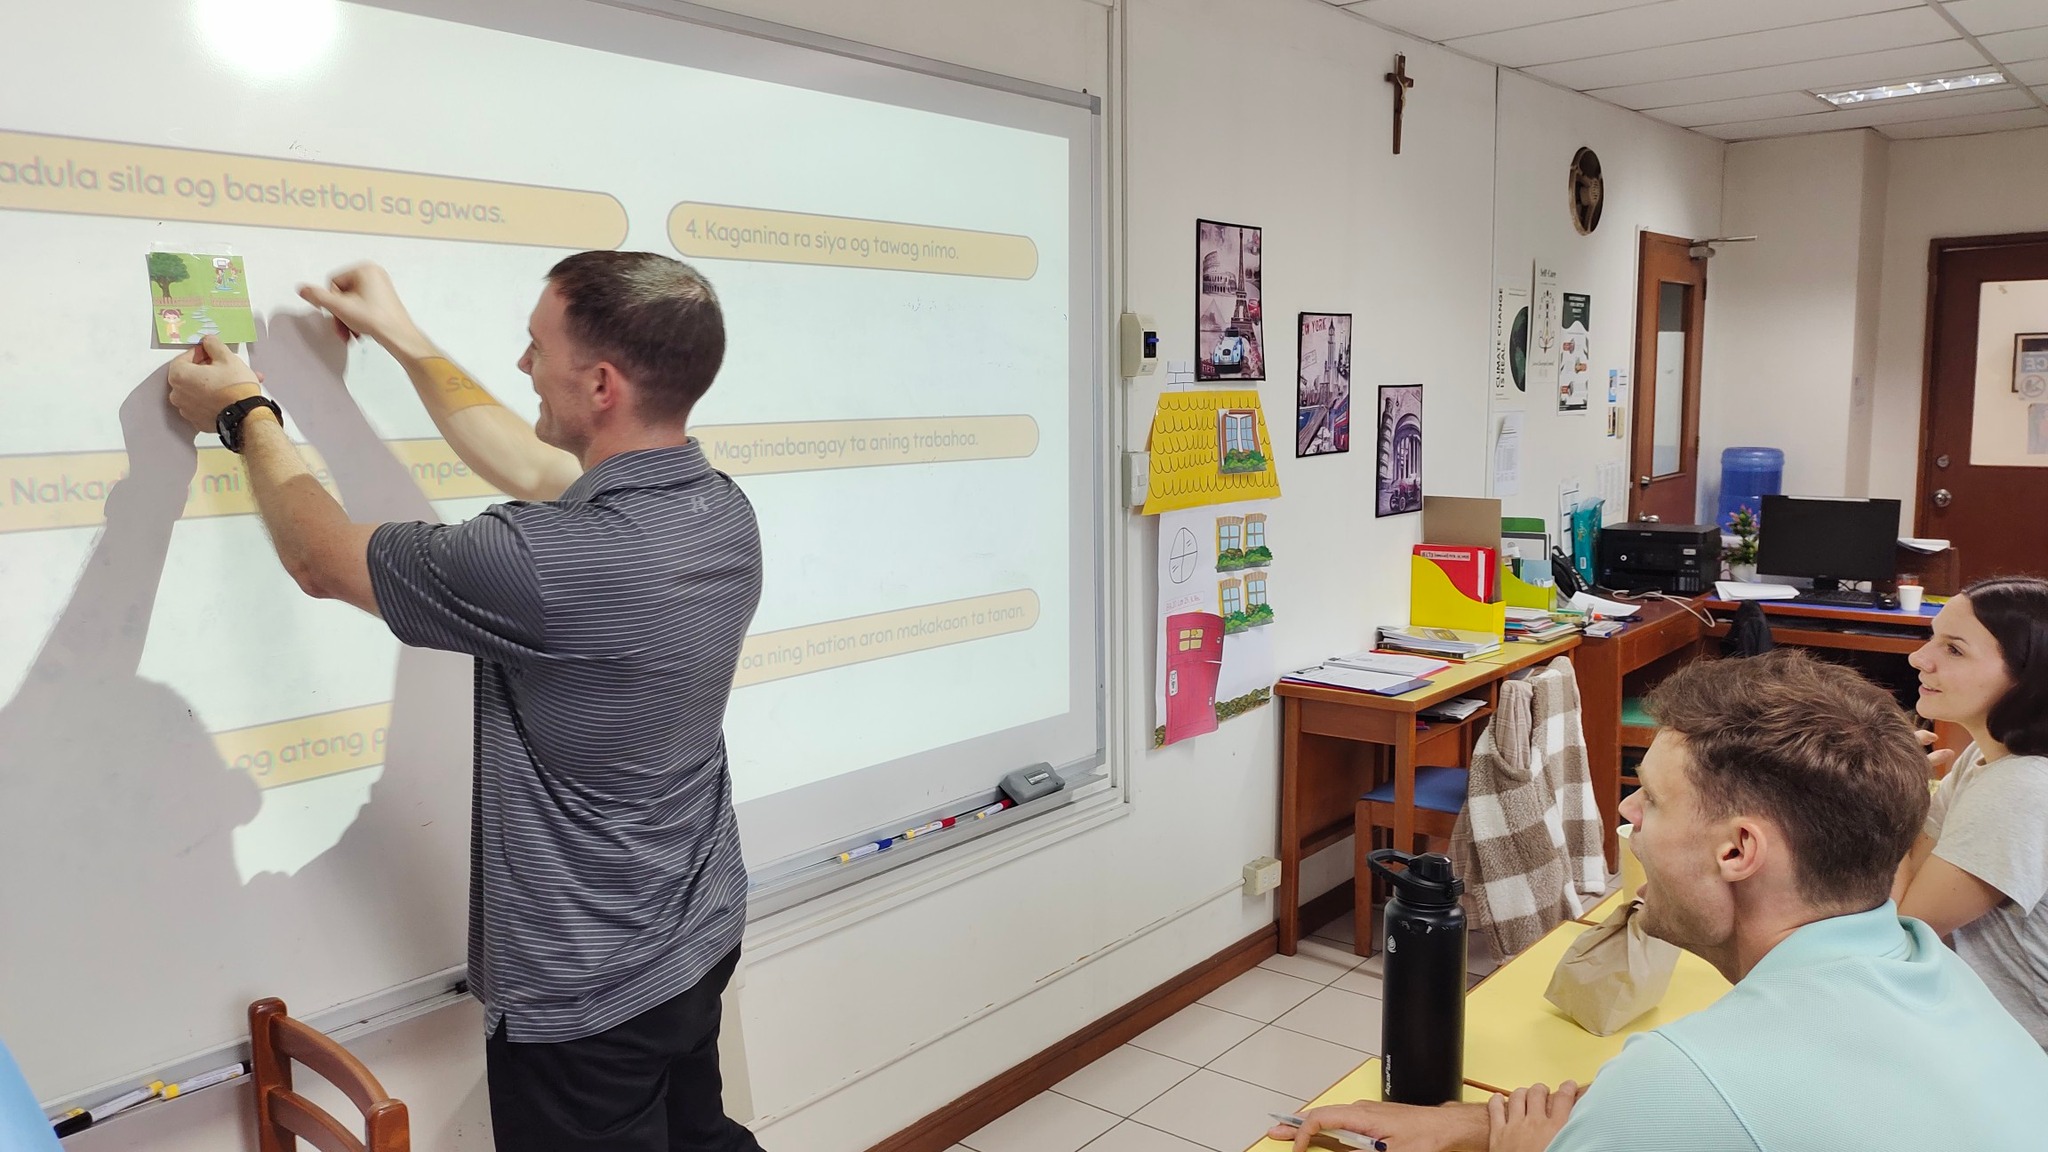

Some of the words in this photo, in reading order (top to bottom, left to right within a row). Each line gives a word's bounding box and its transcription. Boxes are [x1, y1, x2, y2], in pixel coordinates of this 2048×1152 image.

[108, 164, 165, 195] sila
[174, 176, 216, 207] og
[223, 172, 374, 212] basketbol
[381, 195, 412, 215] sa
[419, 199, 505, 224] gawas.
[685, 218, 701, 240] 4.
[705, 219, 789, 248] Kaganina
[793, 233, 811, 248] ra
[815, 230, 846, 255] siya
[850, 240, 869, 258] og
[873, 236, 919, 262] tawag
[922, 240, 959, 261] nimo.
[714, 436, 847, 465] Magtinabangay
[850, 435, 867, 452] ta
[869, 431, 910, 454] aning
[913, 430, 979, 450] trabahoa.
[202, 467, 241, 493] mi
[767, 643, 803, 666] ning
[806, 633, 855, 657] hation
[859, 630, 893, 646] aron
[897, 615, 968, 639] makakaon
[971, 611, 985, 626] ta
[987, 604, 1025, 623] tanan.
[280, 731, 364, 763] atong
